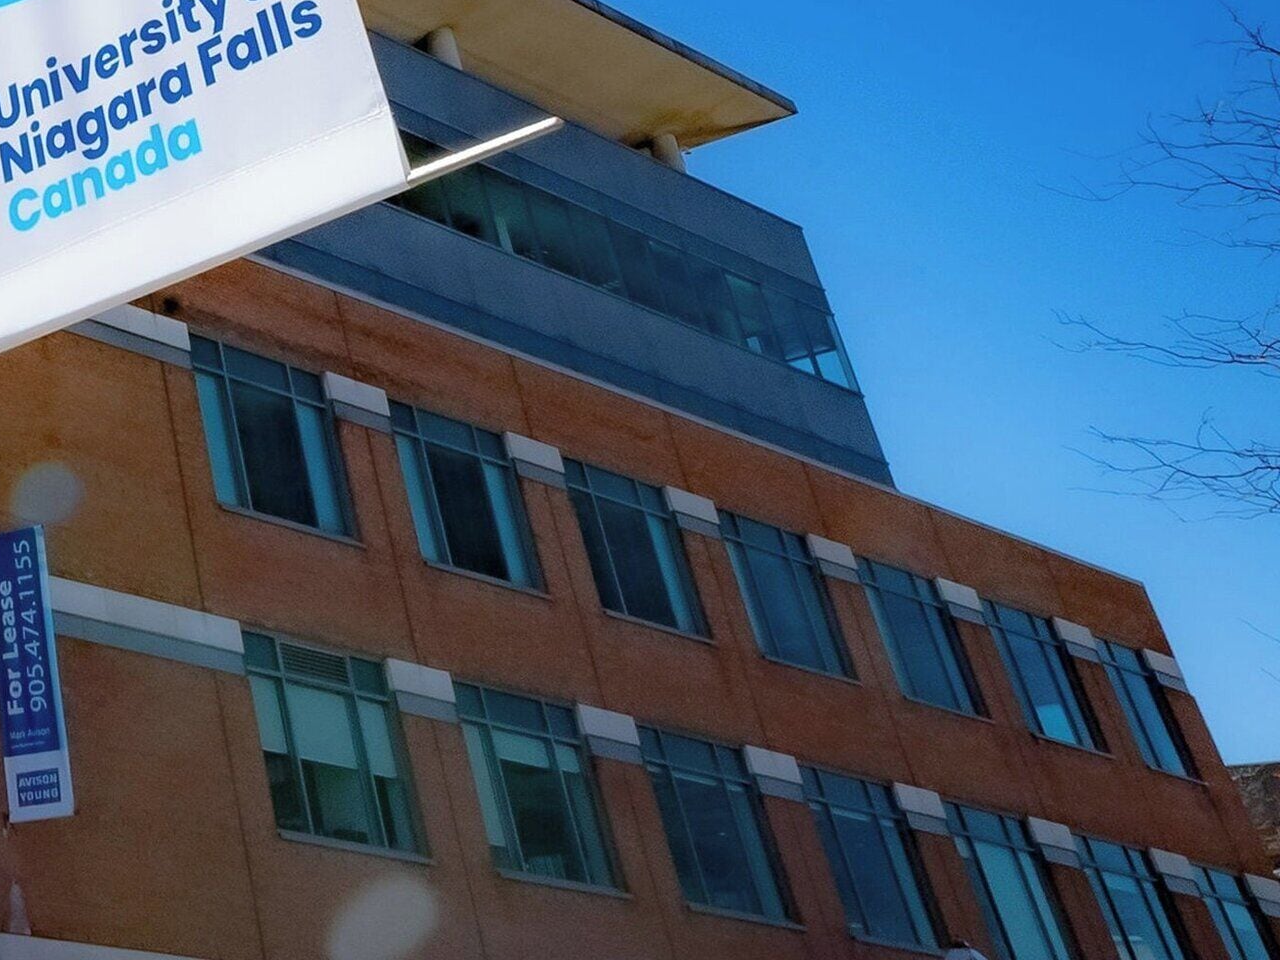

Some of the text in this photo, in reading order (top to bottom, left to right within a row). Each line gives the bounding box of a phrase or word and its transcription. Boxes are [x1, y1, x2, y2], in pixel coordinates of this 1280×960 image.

[0, 63, 193, 183] Niagara
[8, 117, 203, 233] Canada
[0, 579, 25, 716] For Lease
[13, 539, 48, 713] 905.474.1155
[19, 773, 57, 788] AVISON
[20, 787, 59, 802] YOUNG
